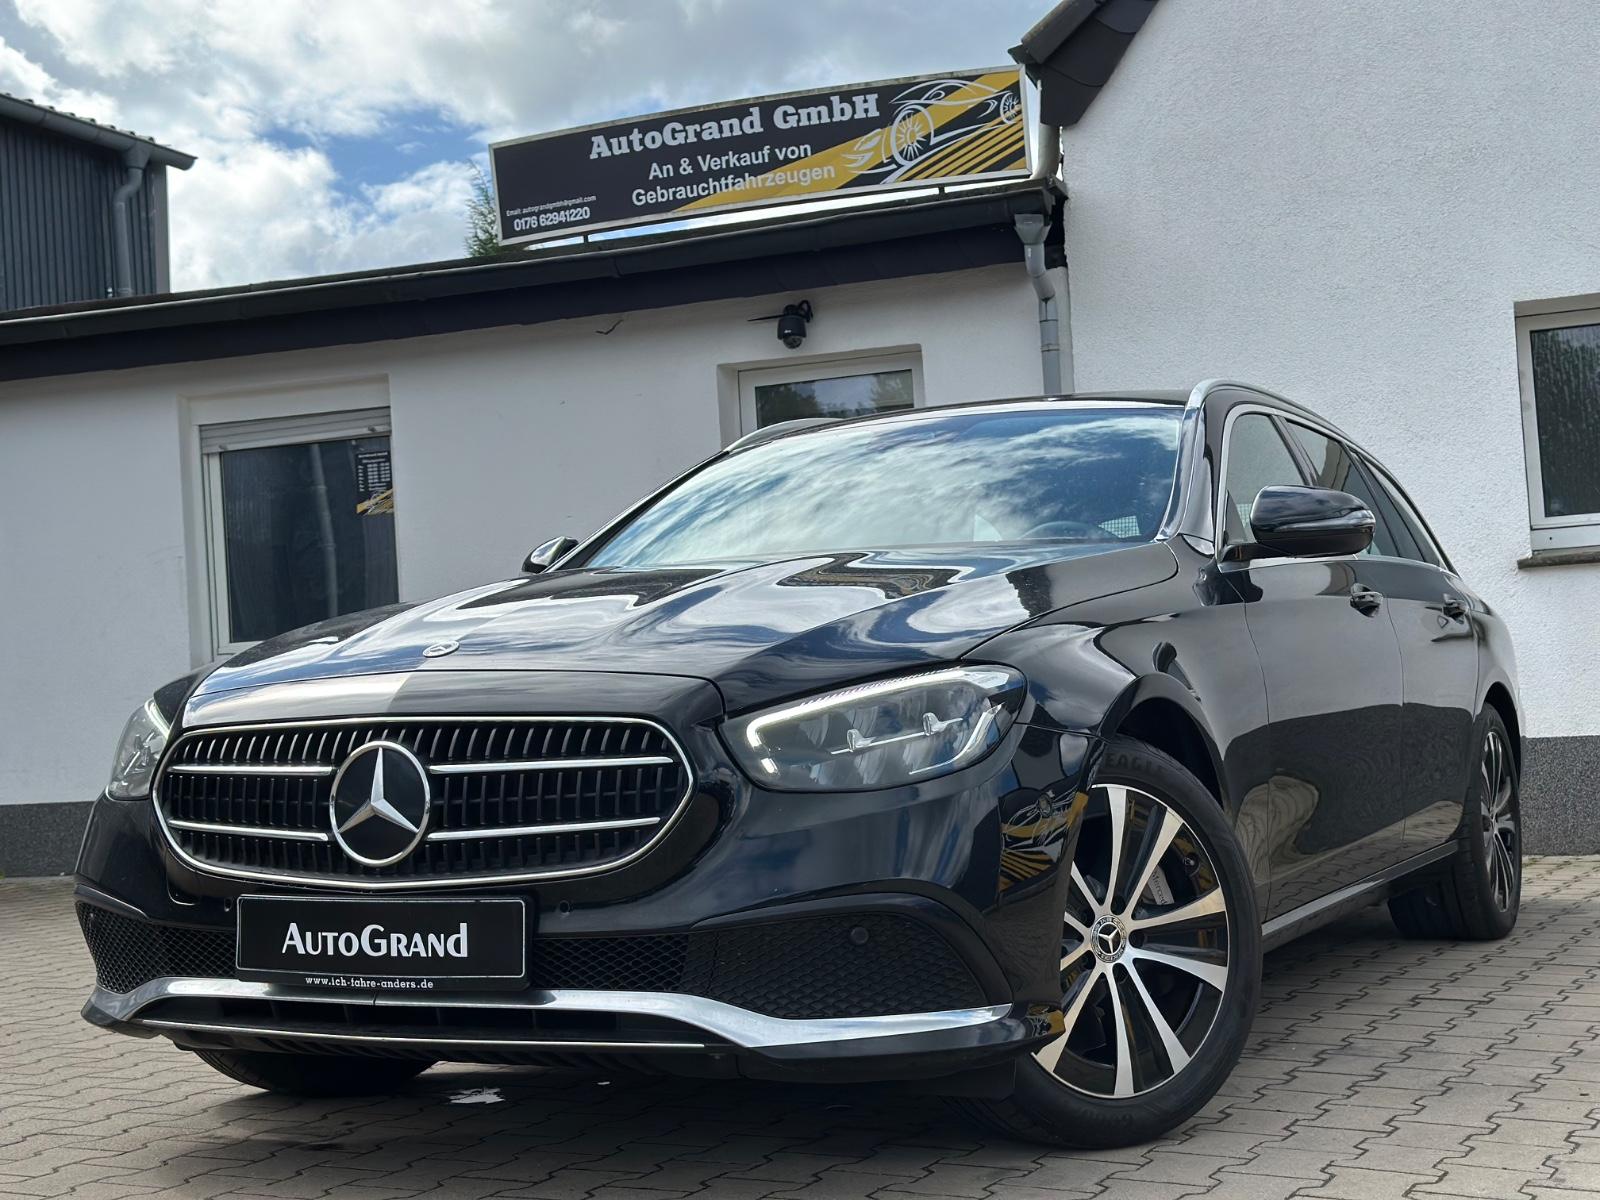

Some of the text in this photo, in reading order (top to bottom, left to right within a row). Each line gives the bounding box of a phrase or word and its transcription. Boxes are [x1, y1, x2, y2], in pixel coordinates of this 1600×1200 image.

[589, 93, 880, 160] AutoGrand GmbH
[649, 143, 812, 180] An & Verkauf von
[631, 165, 836, 206] Gebrauchtfahrzeugen
[513, 206, 590, 231] 0176 62941220
[305, 977, 434, 989] www.ich-fahre-anders.de
